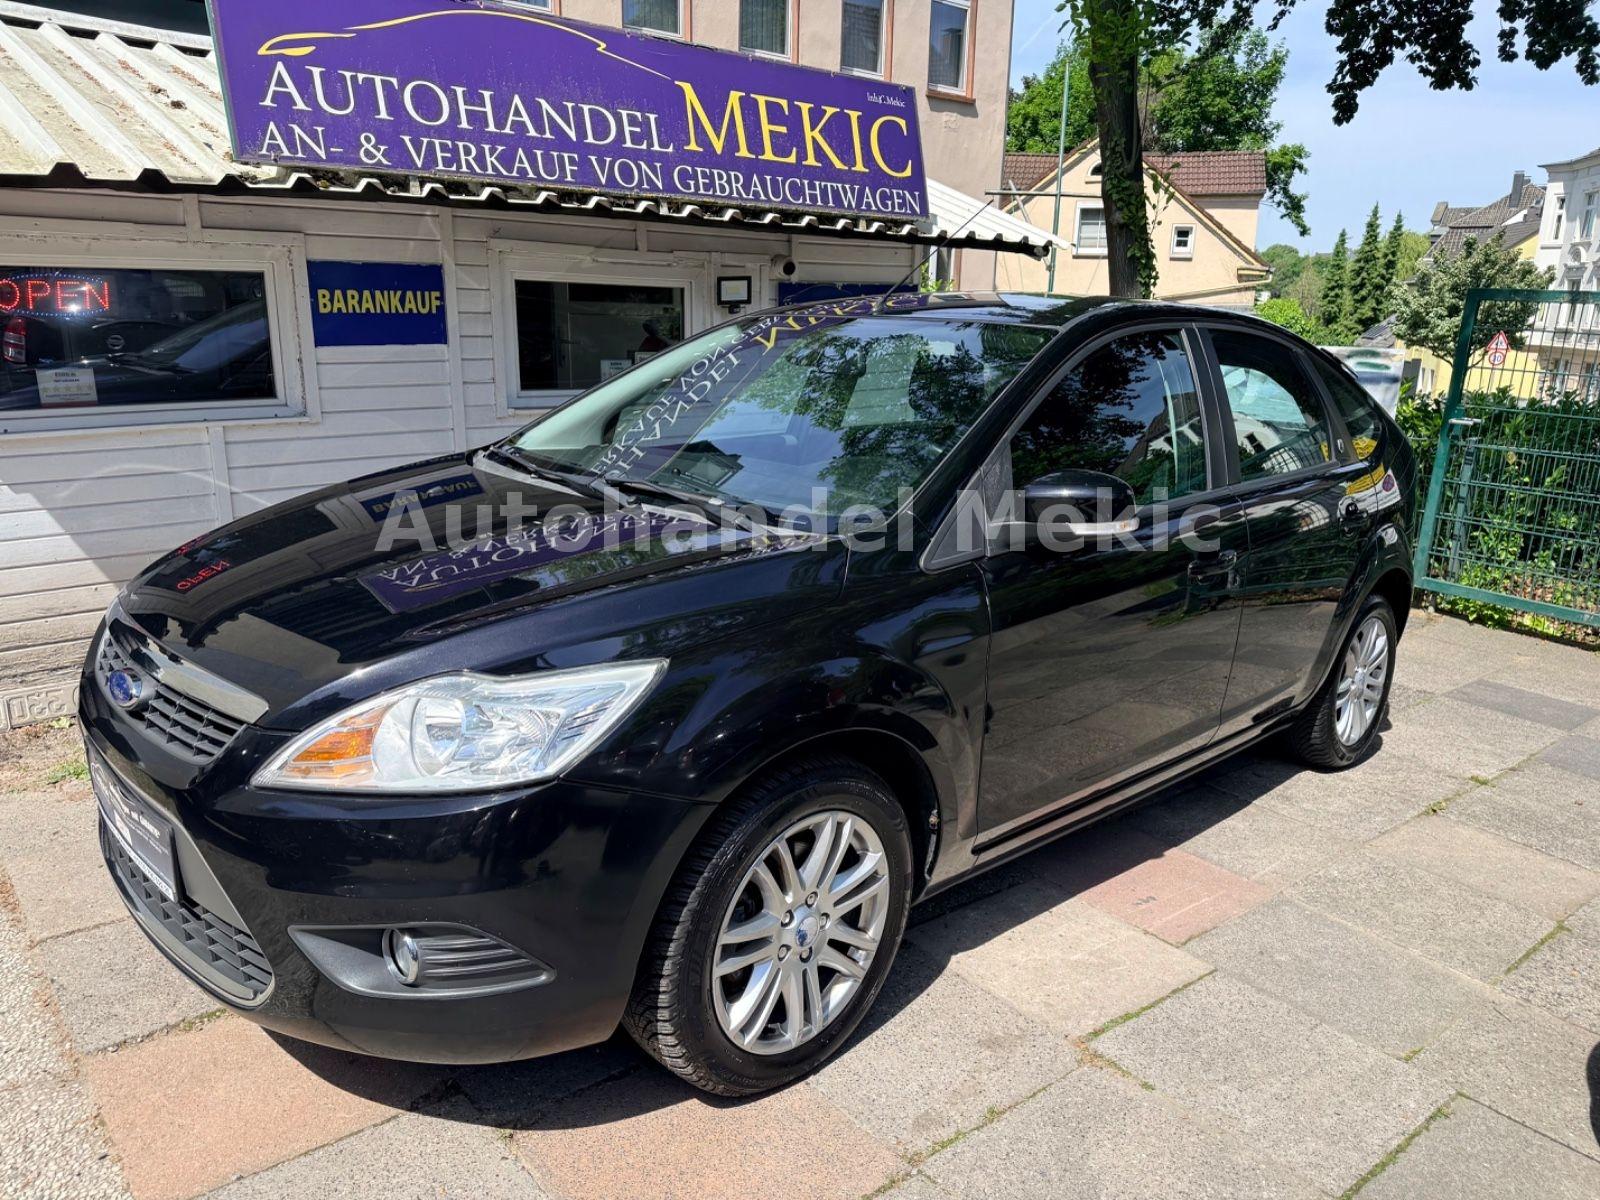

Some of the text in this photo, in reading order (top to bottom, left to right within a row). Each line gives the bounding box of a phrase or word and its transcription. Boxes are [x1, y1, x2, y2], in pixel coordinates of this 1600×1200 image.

[259, 61, 912, 178] AUTOHANDEL MEKIC
[258, 121, 921, 215] AN- & VERKAUF VON GEBRAUCHTWAGEN
[0, 279, 110, 311] OPEN
[317, 288, 441, 314] BARANKAUF
